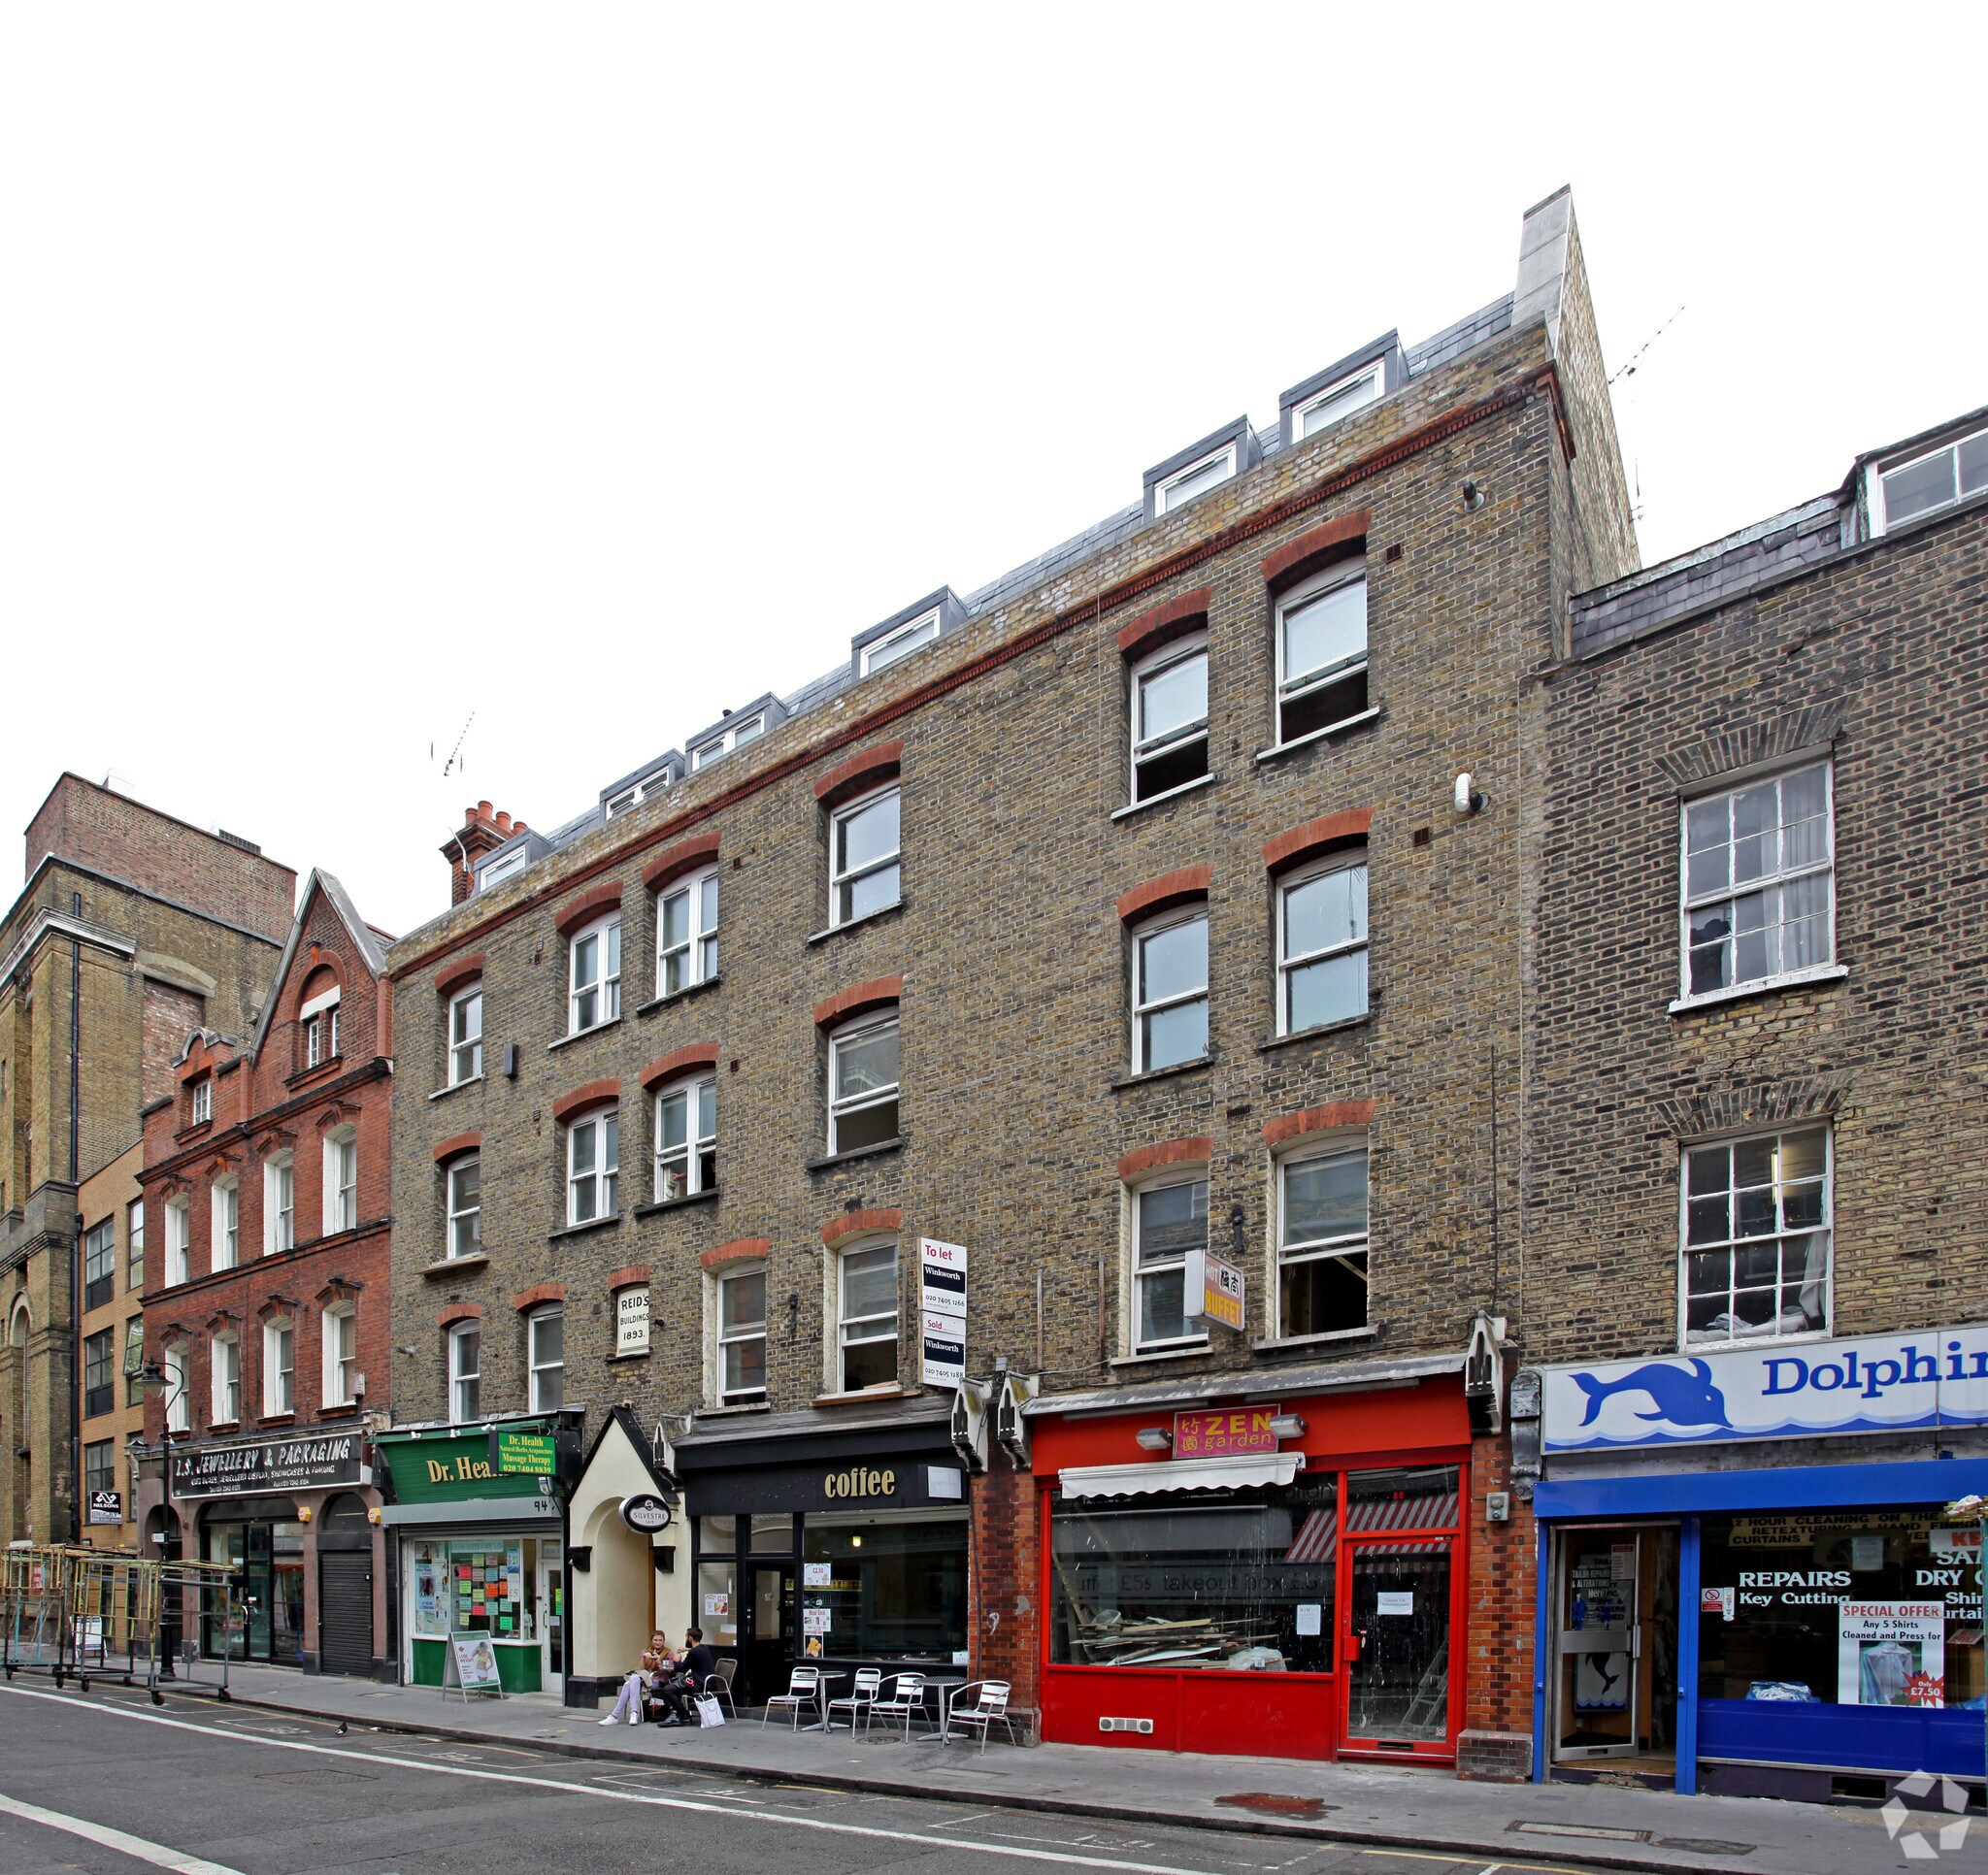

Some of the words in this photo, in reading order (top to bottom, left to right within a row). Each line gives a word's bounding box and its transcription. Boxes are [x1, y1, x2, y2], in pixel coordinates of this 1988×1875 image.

[925, 1244, 937, 1257] To
[939, 1247, 952, 1261] let
[924, 1266, 960, 1281] Winkworth
[1206, 1263, 1218, 1283] HOT
[621, 1294, 649, 1311] REID'S
[938, 1297, 951, 1305] 7405
[1206, 1289, 1241, 1325] BUFFET
[620, 1312, 649, 1326] BUILDINGS
[927, 1319, 943, 1330] Sold
[925, 1339, 959, 1353] Winkworth
[936, 1369, 949, 1378] 7405
[1205, 1412, 1273, 1435] ZEN
[509, 1434, 521, 1445] Dr.
[521, 1436, 544, 1447] Health
[1204, 1431, 1272, 1451] garden
[176, 1458, 194, 1476] L.S.
[196, 1449, 260, 1474] JEWELLERY
[264, 1447, 273, 1466] &
[278, 1438, 350, 1465] PACKAGING
[503, 1453, 527, 1464] Massage
[528, 1455, 550, 1465] Therapy
[426, 1460, 454, 1483] Dr.
[824, 1466, 895, 1498] coffee
[1393, 1491, 1404, 1500] 88
[534, 1500, 547, 1512] 94
[1748, 1517, 1786, 1527] HOUR
[1794, 1514, 1870, 1525] CLEANING
[1878, 1514, 1901, 1523] ON
[1910, 1512, 1938, 1522] THE
[1733, 1534, 1801, 1544] CURTAINS
[1572, 1569, 1589, 1578] TAILOR
[1590, 1568, 1610, 1578] REPAIRS
[1739, 1570, 1851, 1587] REPAIRS
[1915, 1569, 1964, 1586] DRY
[1164, 1573, 1238, 1591] takeout
[1576, 1579, 1609, 1588] ALTERATIONS
[1739, 1592, 1773, 1607] Key
[1781, 1592, 1850, 1606] Cutting
[1843, 1605, 1894, 1617] SPECIAL
[1899, 1605, 1939, 1617] OFFER
[1863, 1620, 1879, 1628] Any
[1883, 1620, 1889, 1628] 5
[1892, 1620, 1919, 1628] Shirts
[1842, 1630, 1876, 1639] Cleaned
[1879, 1630, 1896, 1639] and
[1899, 1630, 1925, 1639] Press
[1928, 1631, 1940, 1640] for
